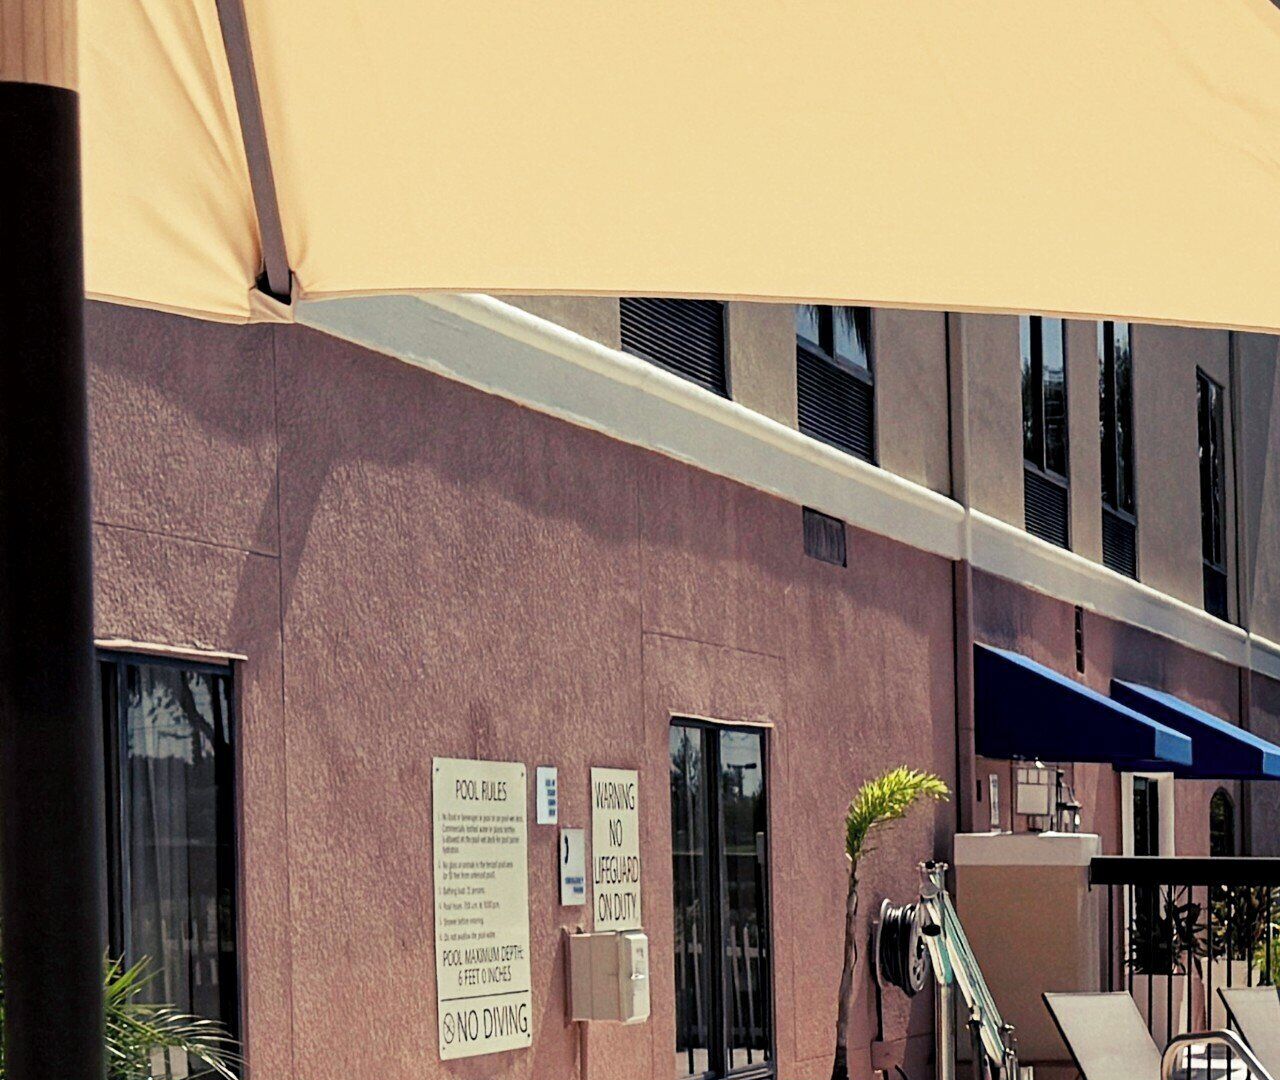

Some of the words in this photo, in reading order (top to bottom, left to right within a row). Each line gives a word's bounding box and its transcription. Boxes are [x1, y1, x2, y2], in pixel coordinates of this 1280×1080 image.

[456, 780, 479, 800] POOL
[482, 780, 507, 801] RULES
[595, 782, 635, 810] WARNING
[609, 819, 623, 847] NO
[594, 856, 639, 884] LIFEGUARD
[599, 893, 612, 921] ON
[614, 892, 637, 921] DUTY
[443, 949, 462, 966] POOL
[465, 946, 499, 964] MAXIMUM
[465, 968, 480, 985] FEET
[488, 965, 511, 983] INCHES
[457, 1009, 478, 1042] NO
[483, 1003, 528, 1039] DIVING
